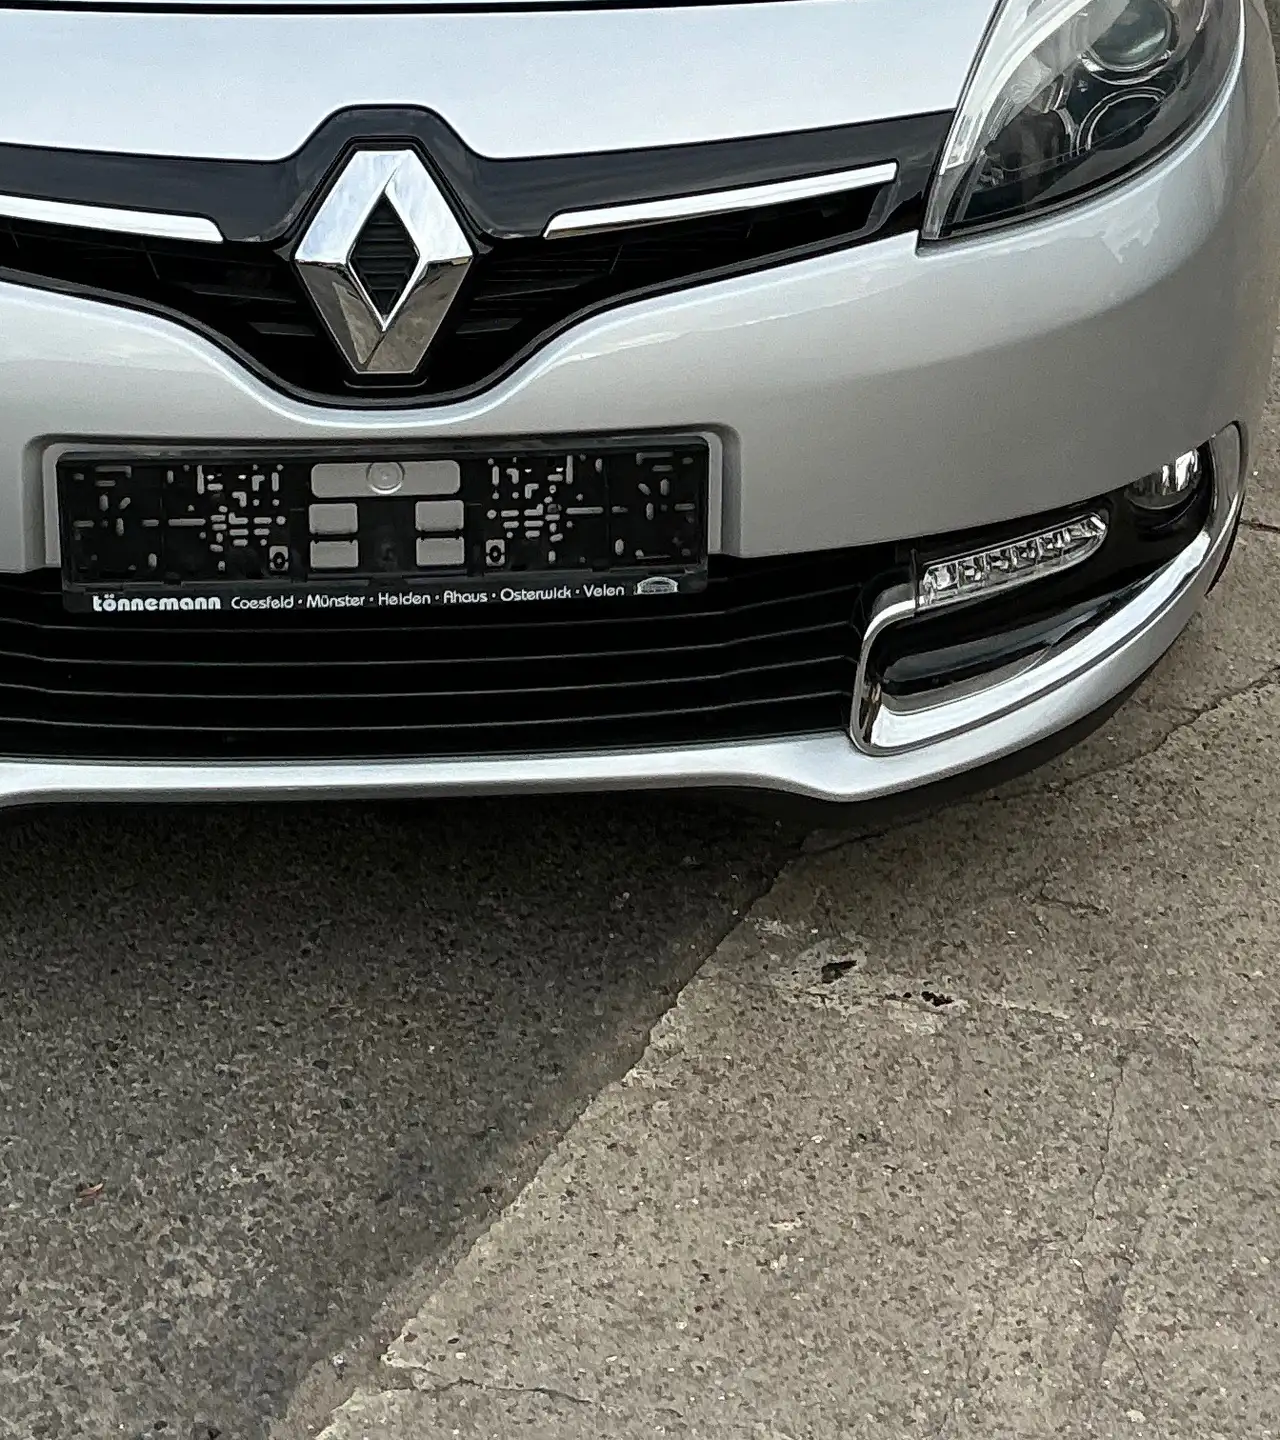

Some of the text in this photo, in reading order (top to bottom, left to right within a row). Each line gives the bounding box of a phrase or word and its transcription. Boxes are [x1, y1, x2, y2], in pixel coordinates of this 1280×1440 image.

[92, 593, 221, 612] tönnemann
[231, 594, 294, 610] Coesfeld
[306, 593, 366, 609] Münster
[443, 590, 489, 604] Ahaus
[582, 583, 625, 598] Velen
